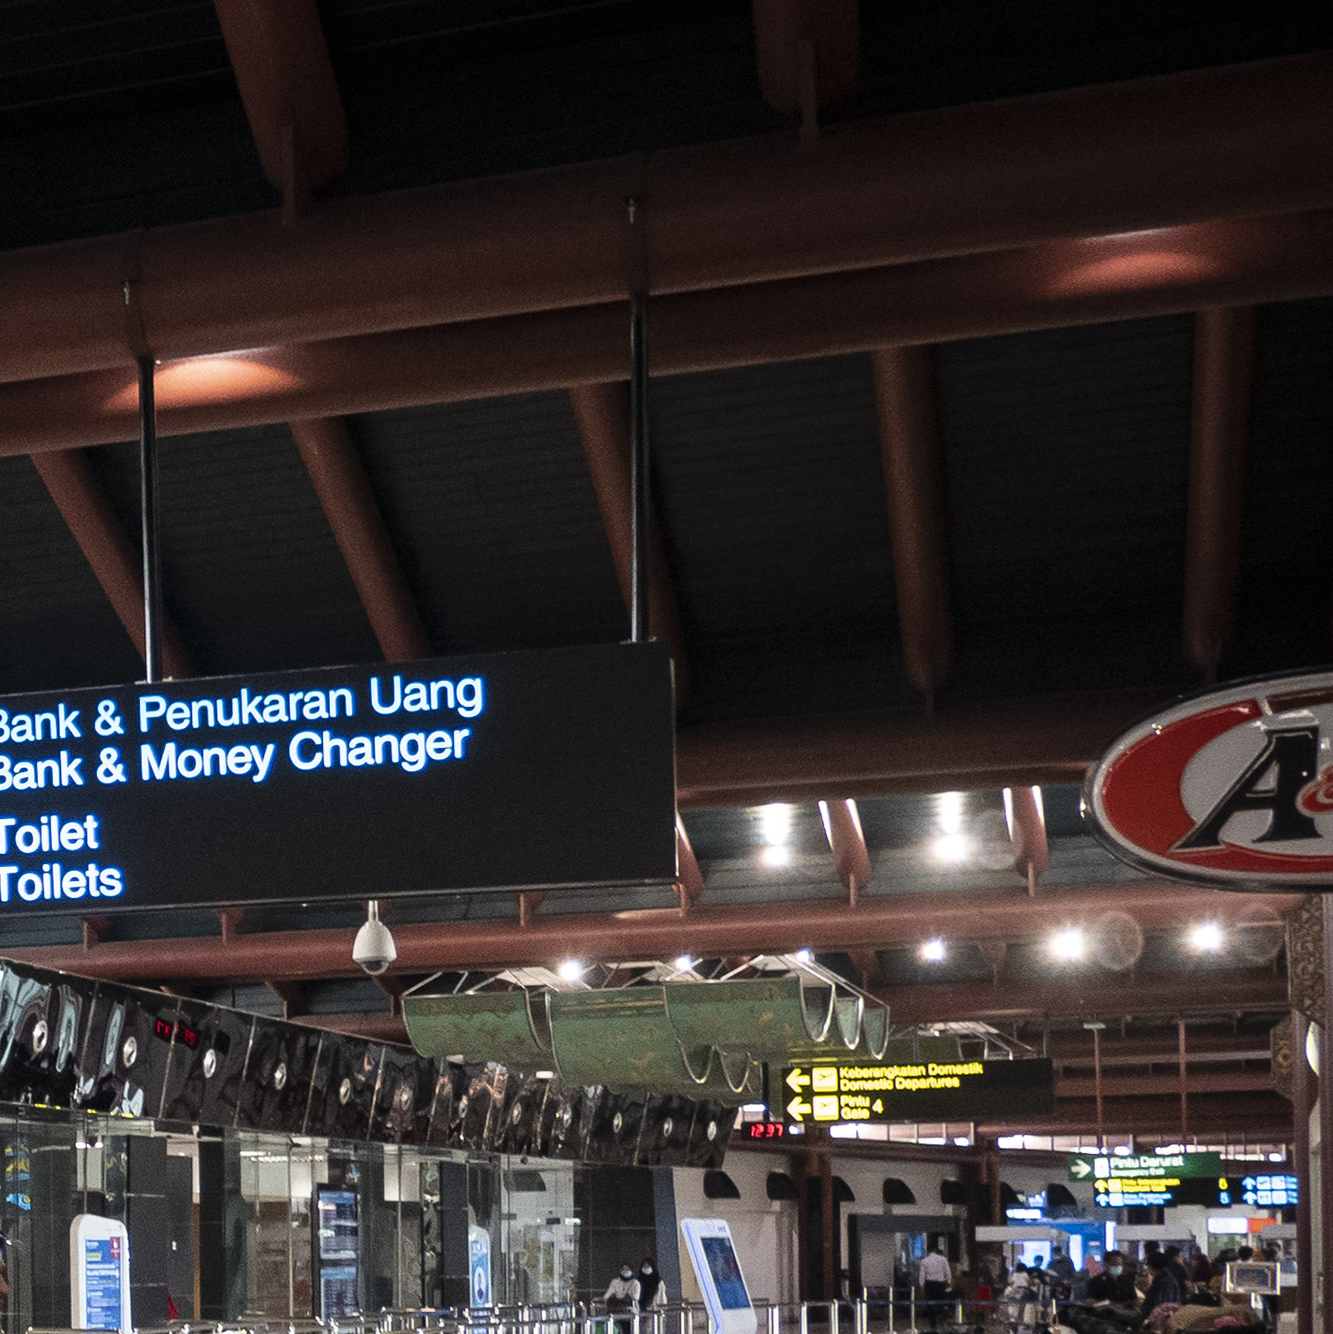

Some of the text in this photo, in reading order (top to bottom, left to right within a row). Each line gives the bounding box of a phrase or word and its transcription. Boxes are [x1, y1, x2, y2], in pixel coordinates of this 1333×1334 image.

[95, 699, 125, 736] &
[139, 686, 355, 732] Penukaran
[370, 675, 485, 718] Uang
[96, 747, 129, 784] &
[140, 739, 272, 784] Money
[288, 728, 471, 772] Changer
[840, 1062, 984, 1079] Keberangkatan Domestik
[840, 1077, 960, 1091] Domestic Departures
